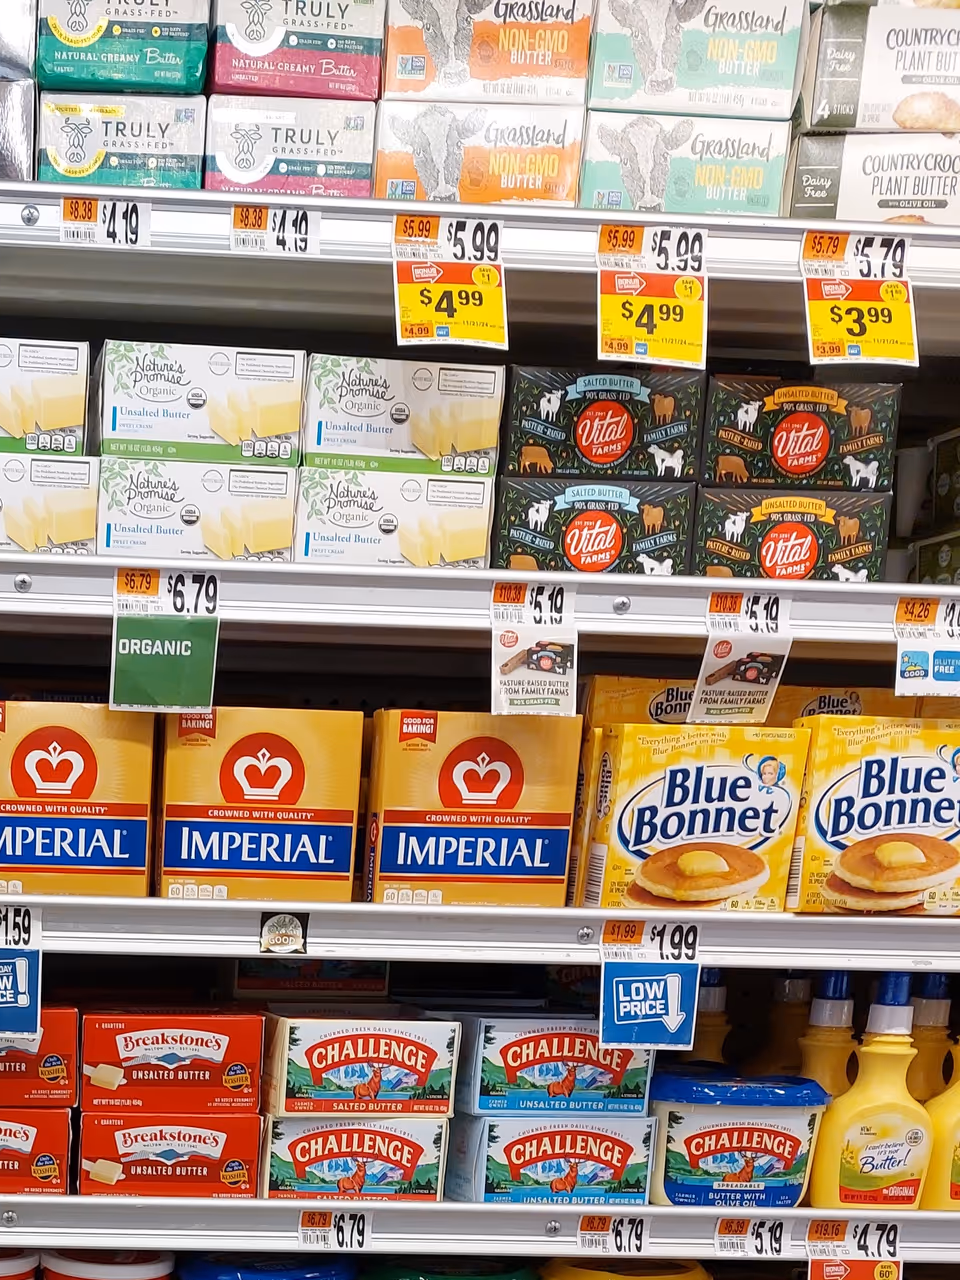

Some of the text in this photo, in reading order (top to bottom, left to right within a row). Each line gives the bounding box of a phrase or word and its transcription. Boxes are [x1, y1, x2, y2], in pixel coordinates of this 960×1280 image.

[499, 29, 568, 54] NON-GMO
[55, 48, 183, 66] NATURAL CREAMY Butter
[827, 49, 856, 65] Dairy
[829, 61, 852, 73] Free
[103, 122, 170, 139] TRULY
[872, 176, 957, 197] PLANT BUTTER
[899, 201, 936, 209] OLIVE OIL
[103, 204, 139, 245] $4.19
[447, 221, 499, 262] $5.99
[651, 231, 704, 274] $5.99
[854, 238, 906, 279] $5.79
[583, 379, 635, 390] SALTED BUTTER
[120, 407, 191, 421] Unsalted Butter
[579, 415, 628, 445] Vital
[168, 574, 218, 615] $6.79
[904, 600, 931, 621] $4.26
[119, 640, 192, 656] ORGANIC
[935, 666, 956, 675] FREE
[664, 767, 752, 809] Blue
[1, 804, 106, 815] CROWNED WITH QUALITY
[631, 806, 779, 845] Bonnet
[651, 924, 699, 961] $1.99
[619, 984, 666, 1002] LOW
[620, 999, 666, 1016] PRICE
[312, 1039, 430, 1073] CHALLENGE
[333, 1101, 403, 1112] SALTED BUTTER
[692, 1133, 795, 1159] CHALLENGE
[861, 1149, 909, 1175] Butter!
[709, 1192, 766, 1201] BUTTER WITH
[888, 1186, 915, 1198] ORIGINAL
[853, 1224, 899, 1258] $4.79
